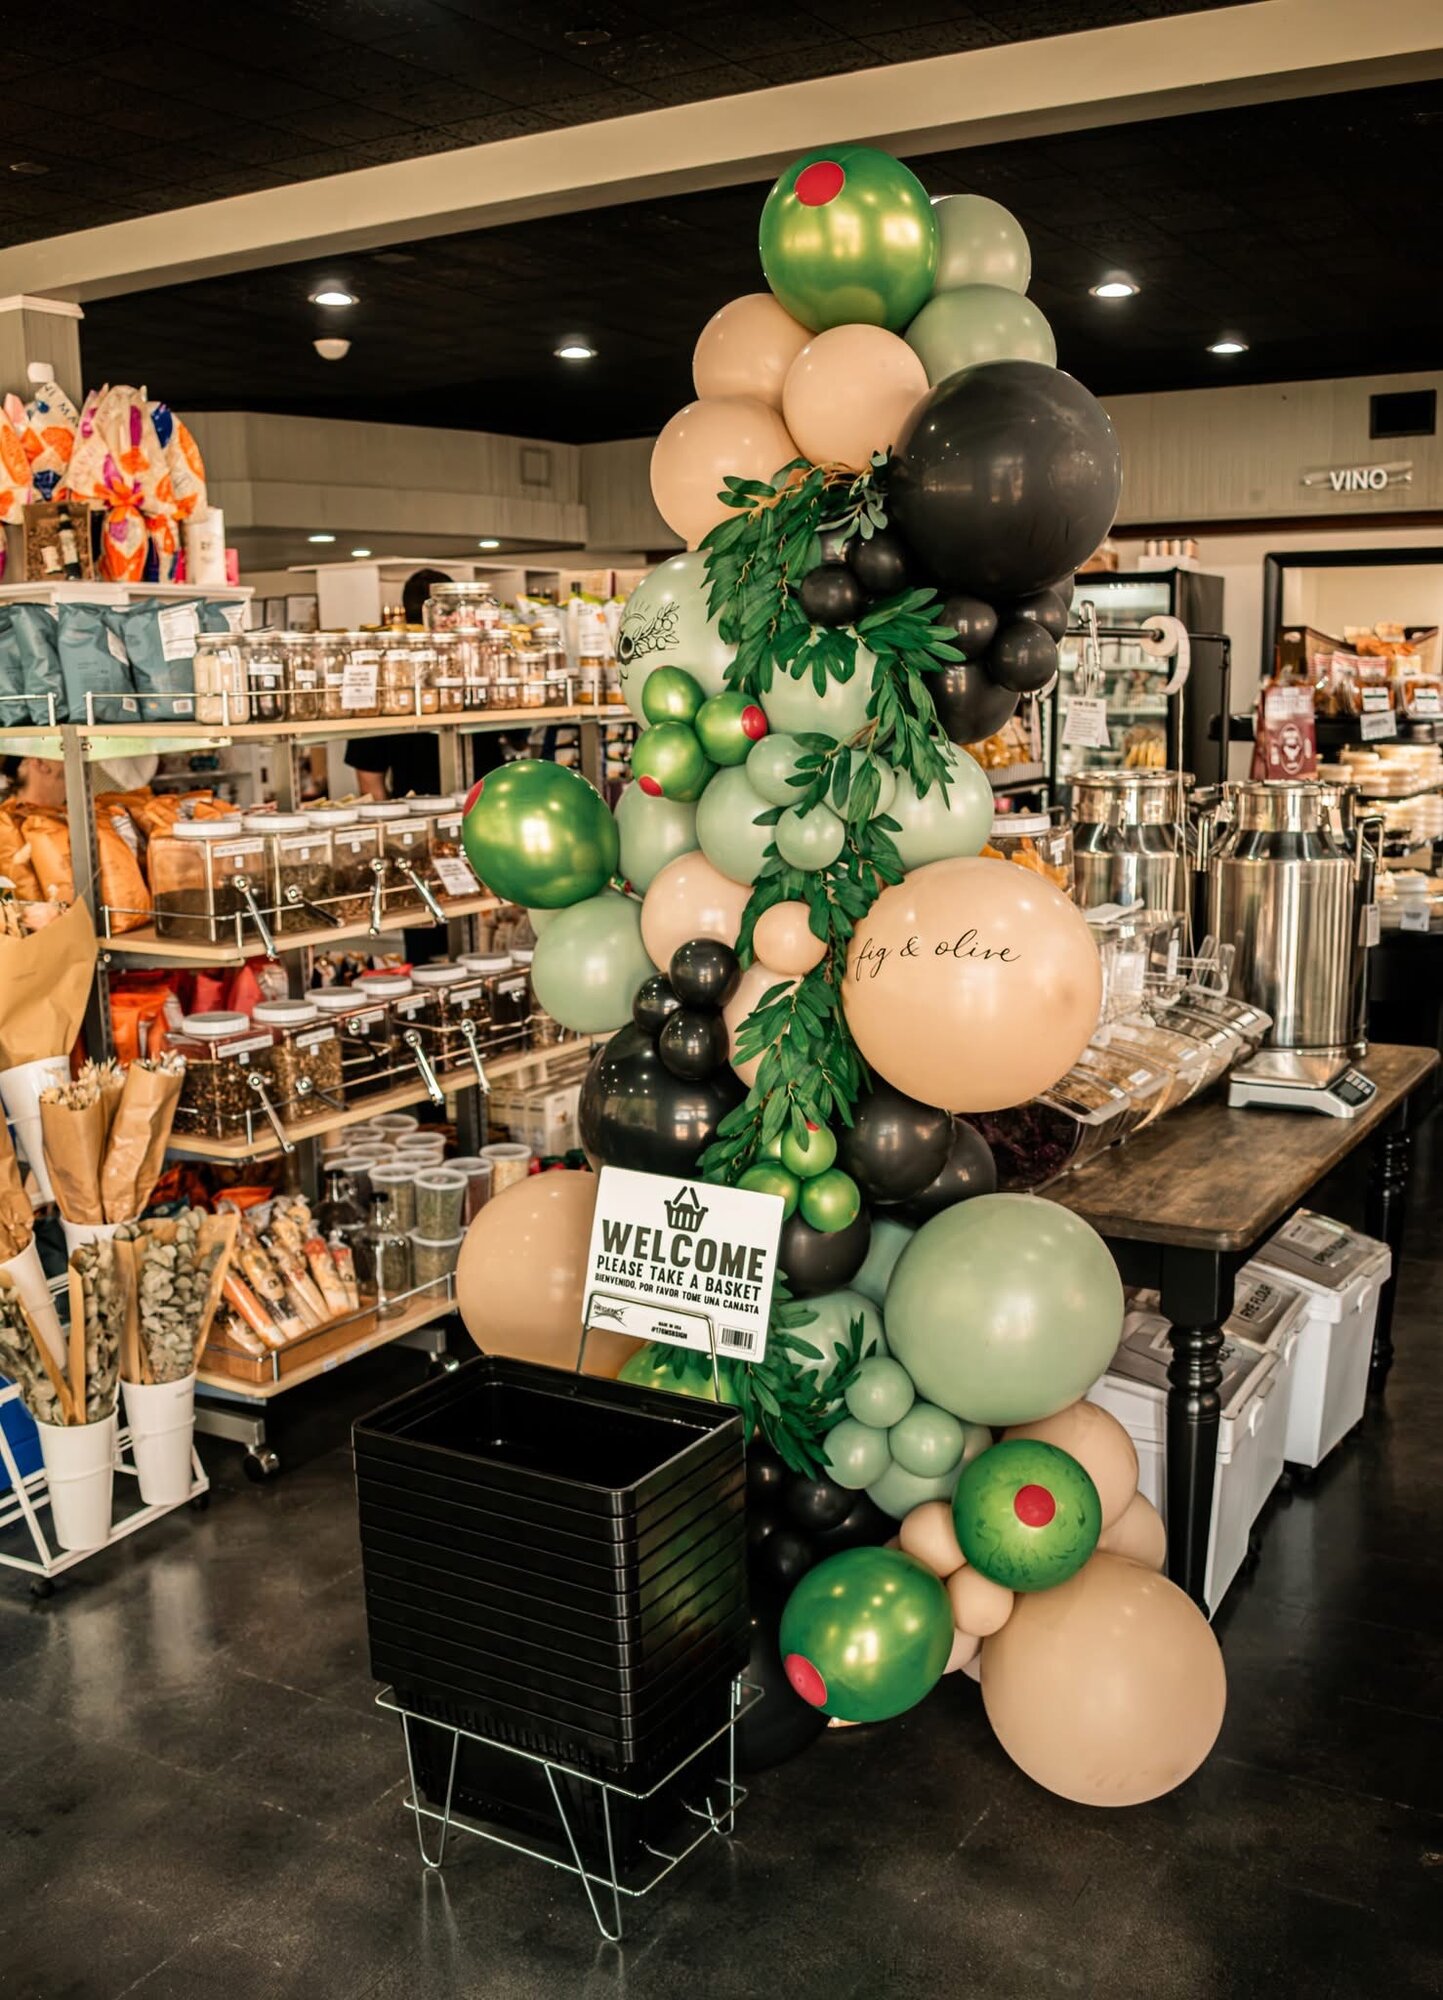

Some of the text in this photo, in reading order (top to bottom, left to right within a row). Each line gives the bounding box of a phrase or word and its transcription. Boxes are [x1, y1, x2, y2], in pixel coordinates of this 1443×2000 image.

[1329, 469, 1388, 491] VINO
[855, 928, 1021, 982] fig & olive
[602, 1218, 767, 1283] WELCOME
[595, 1272, 760, 1315] BIENVENIDO, POR FAVOR TOME UNA CANASTA
[597, 1254, 762, 1302] PLEASE TAKE A BASKET
[1250, 1284, 1273, 1310] FLOUR
